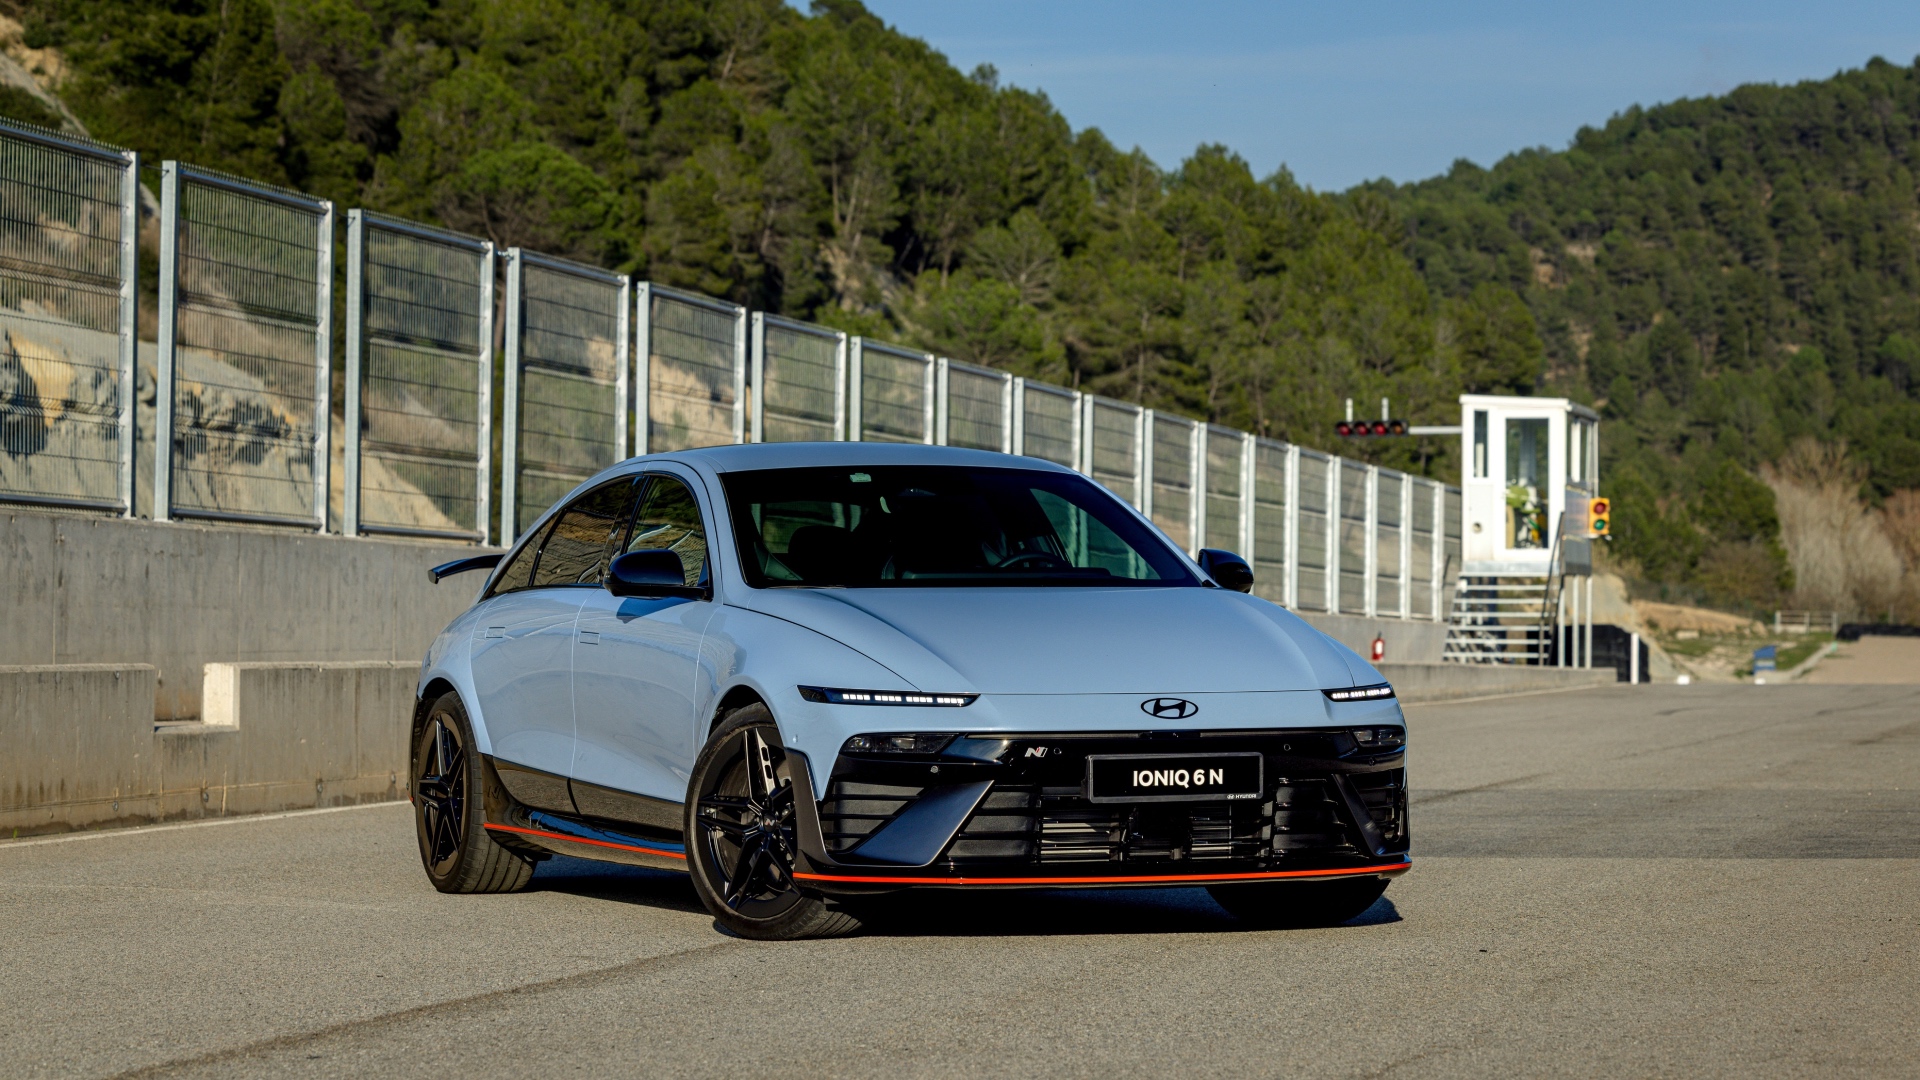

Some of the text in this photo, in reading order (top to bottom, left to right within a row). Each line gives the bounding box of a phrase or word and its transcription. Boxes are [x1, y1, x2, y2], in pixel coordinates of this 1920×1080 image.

[1133, 769, 1223, 789] IONIQ 6 N
